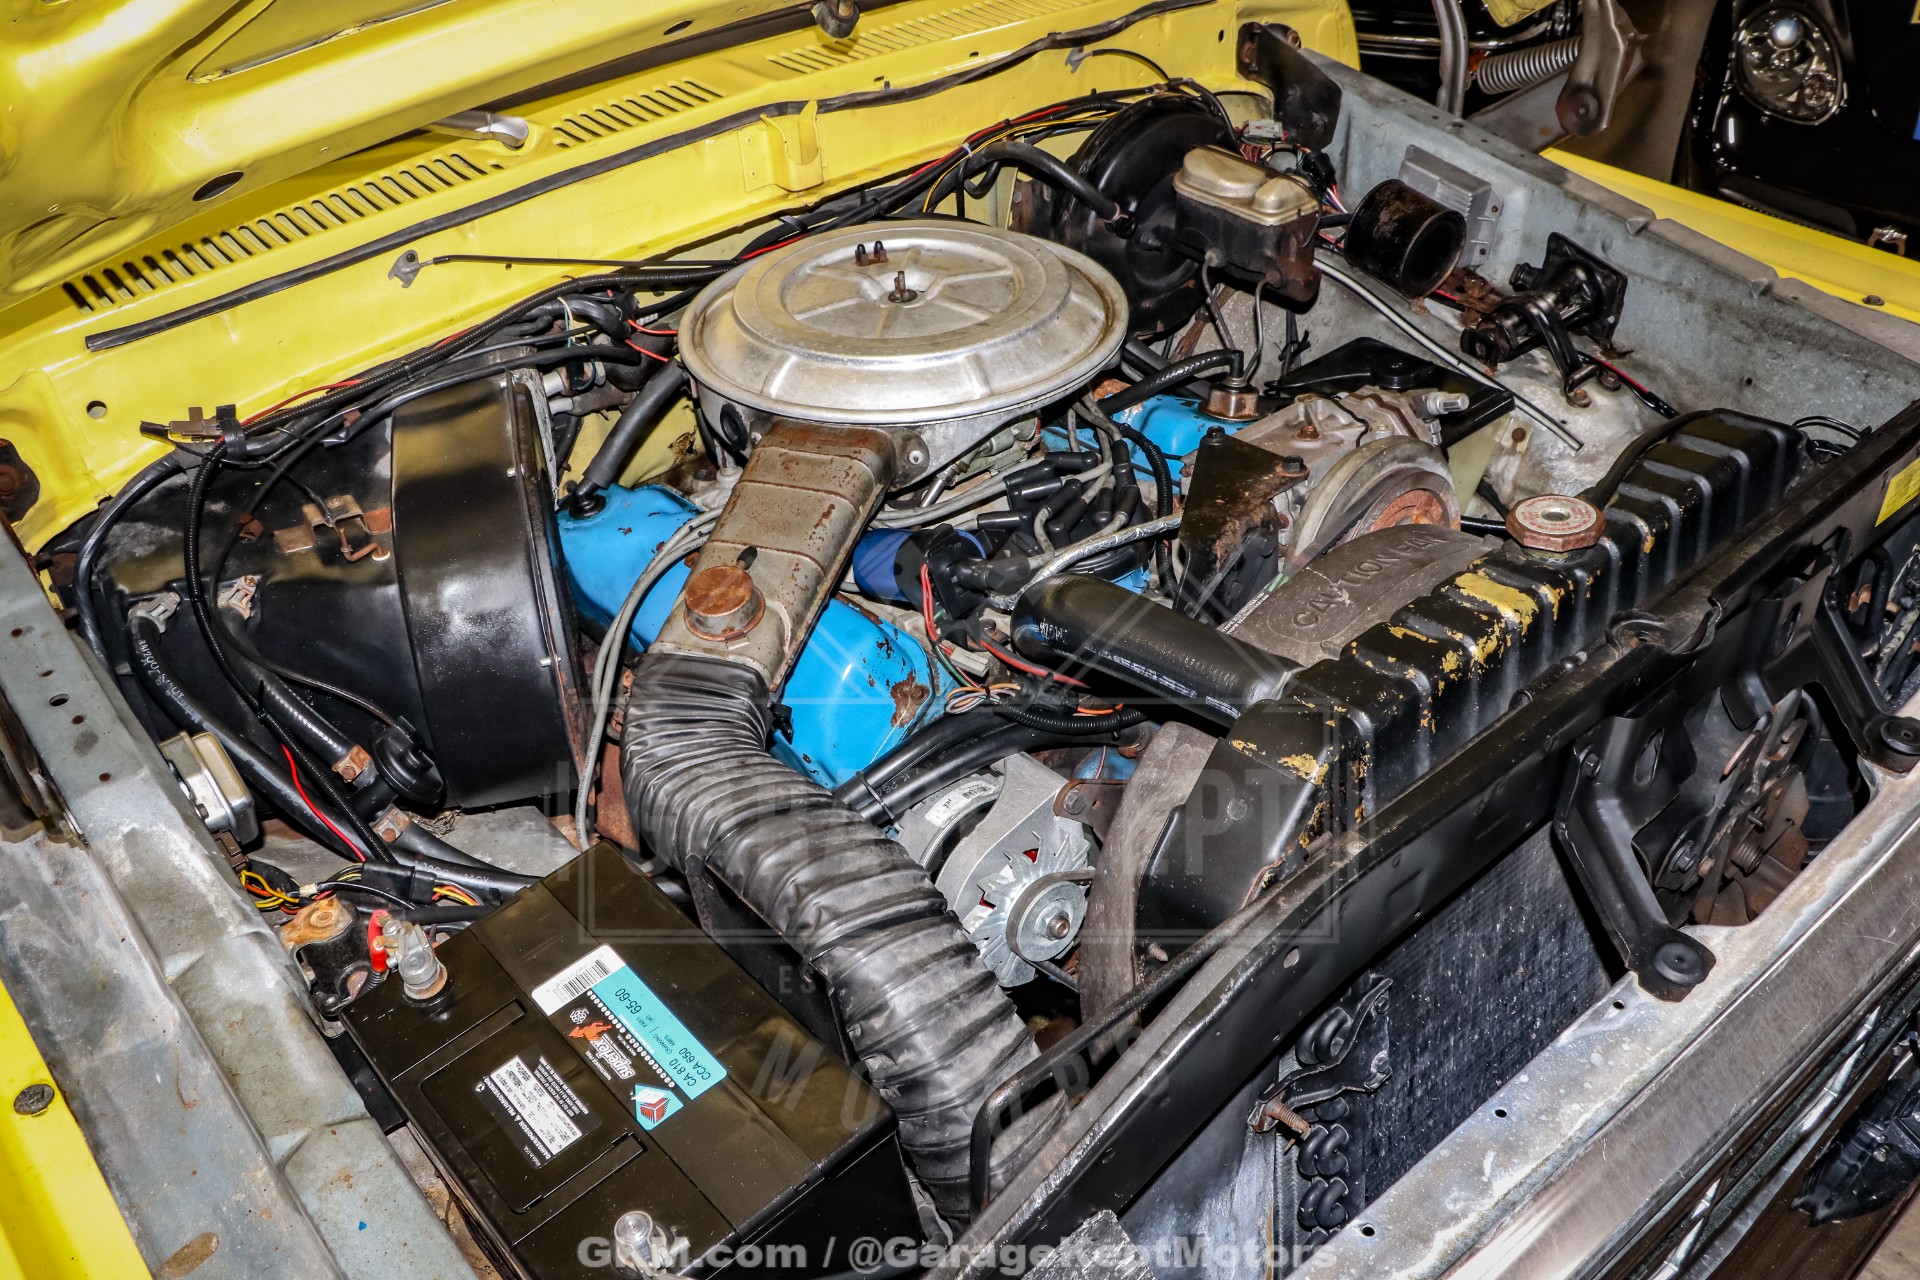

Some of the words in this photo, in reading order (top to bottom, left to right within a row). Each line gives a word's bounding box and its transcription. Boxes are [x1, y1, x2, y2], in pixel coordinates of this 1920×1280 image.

[1293, 551, 1400, 628] CAUTION
[614, 985, 642, 1016] 65-60
[678, 1046, 695, 1064] 650
[668, 1057, 686, 1075] 810
[691, 1060, 711, 1081] CCA
[682, 1072, 697, 1087] CA
